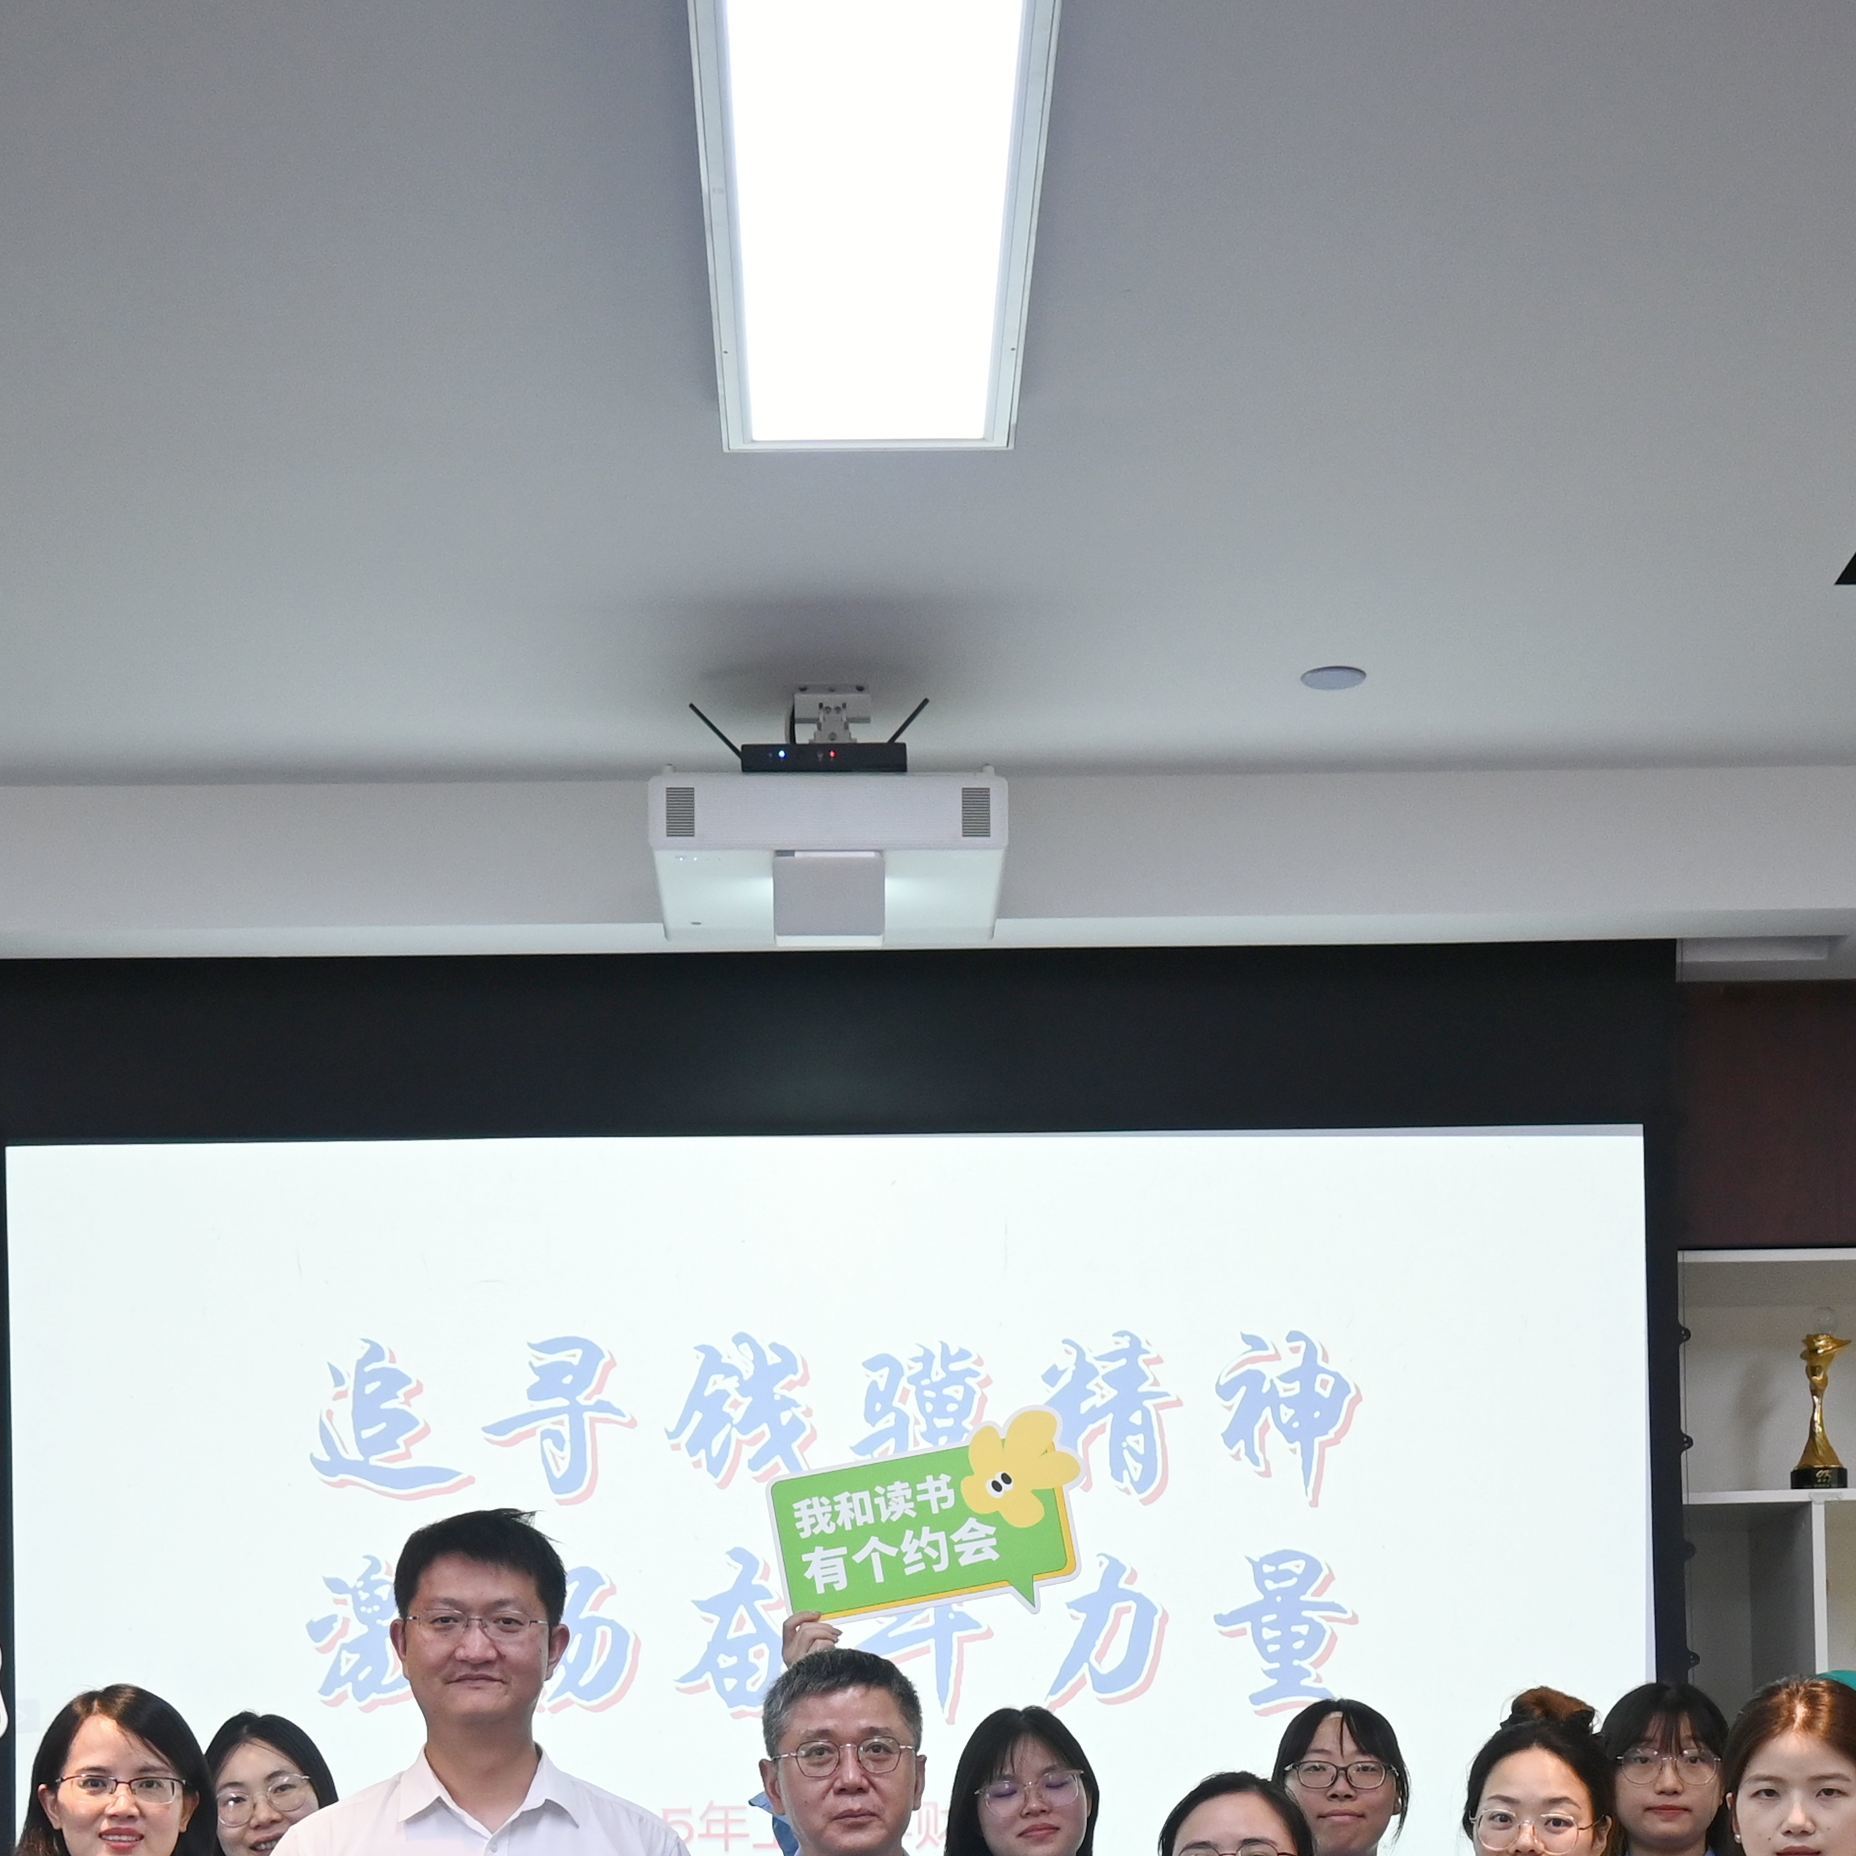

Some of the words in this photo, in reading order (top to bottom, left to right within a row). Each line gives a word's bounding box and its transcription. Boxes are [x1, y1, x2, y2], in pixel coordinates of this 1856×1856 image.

[791, 1473, 957, 1539] 我和读书
[802, 1517, 1001, 1594] 有个约会
